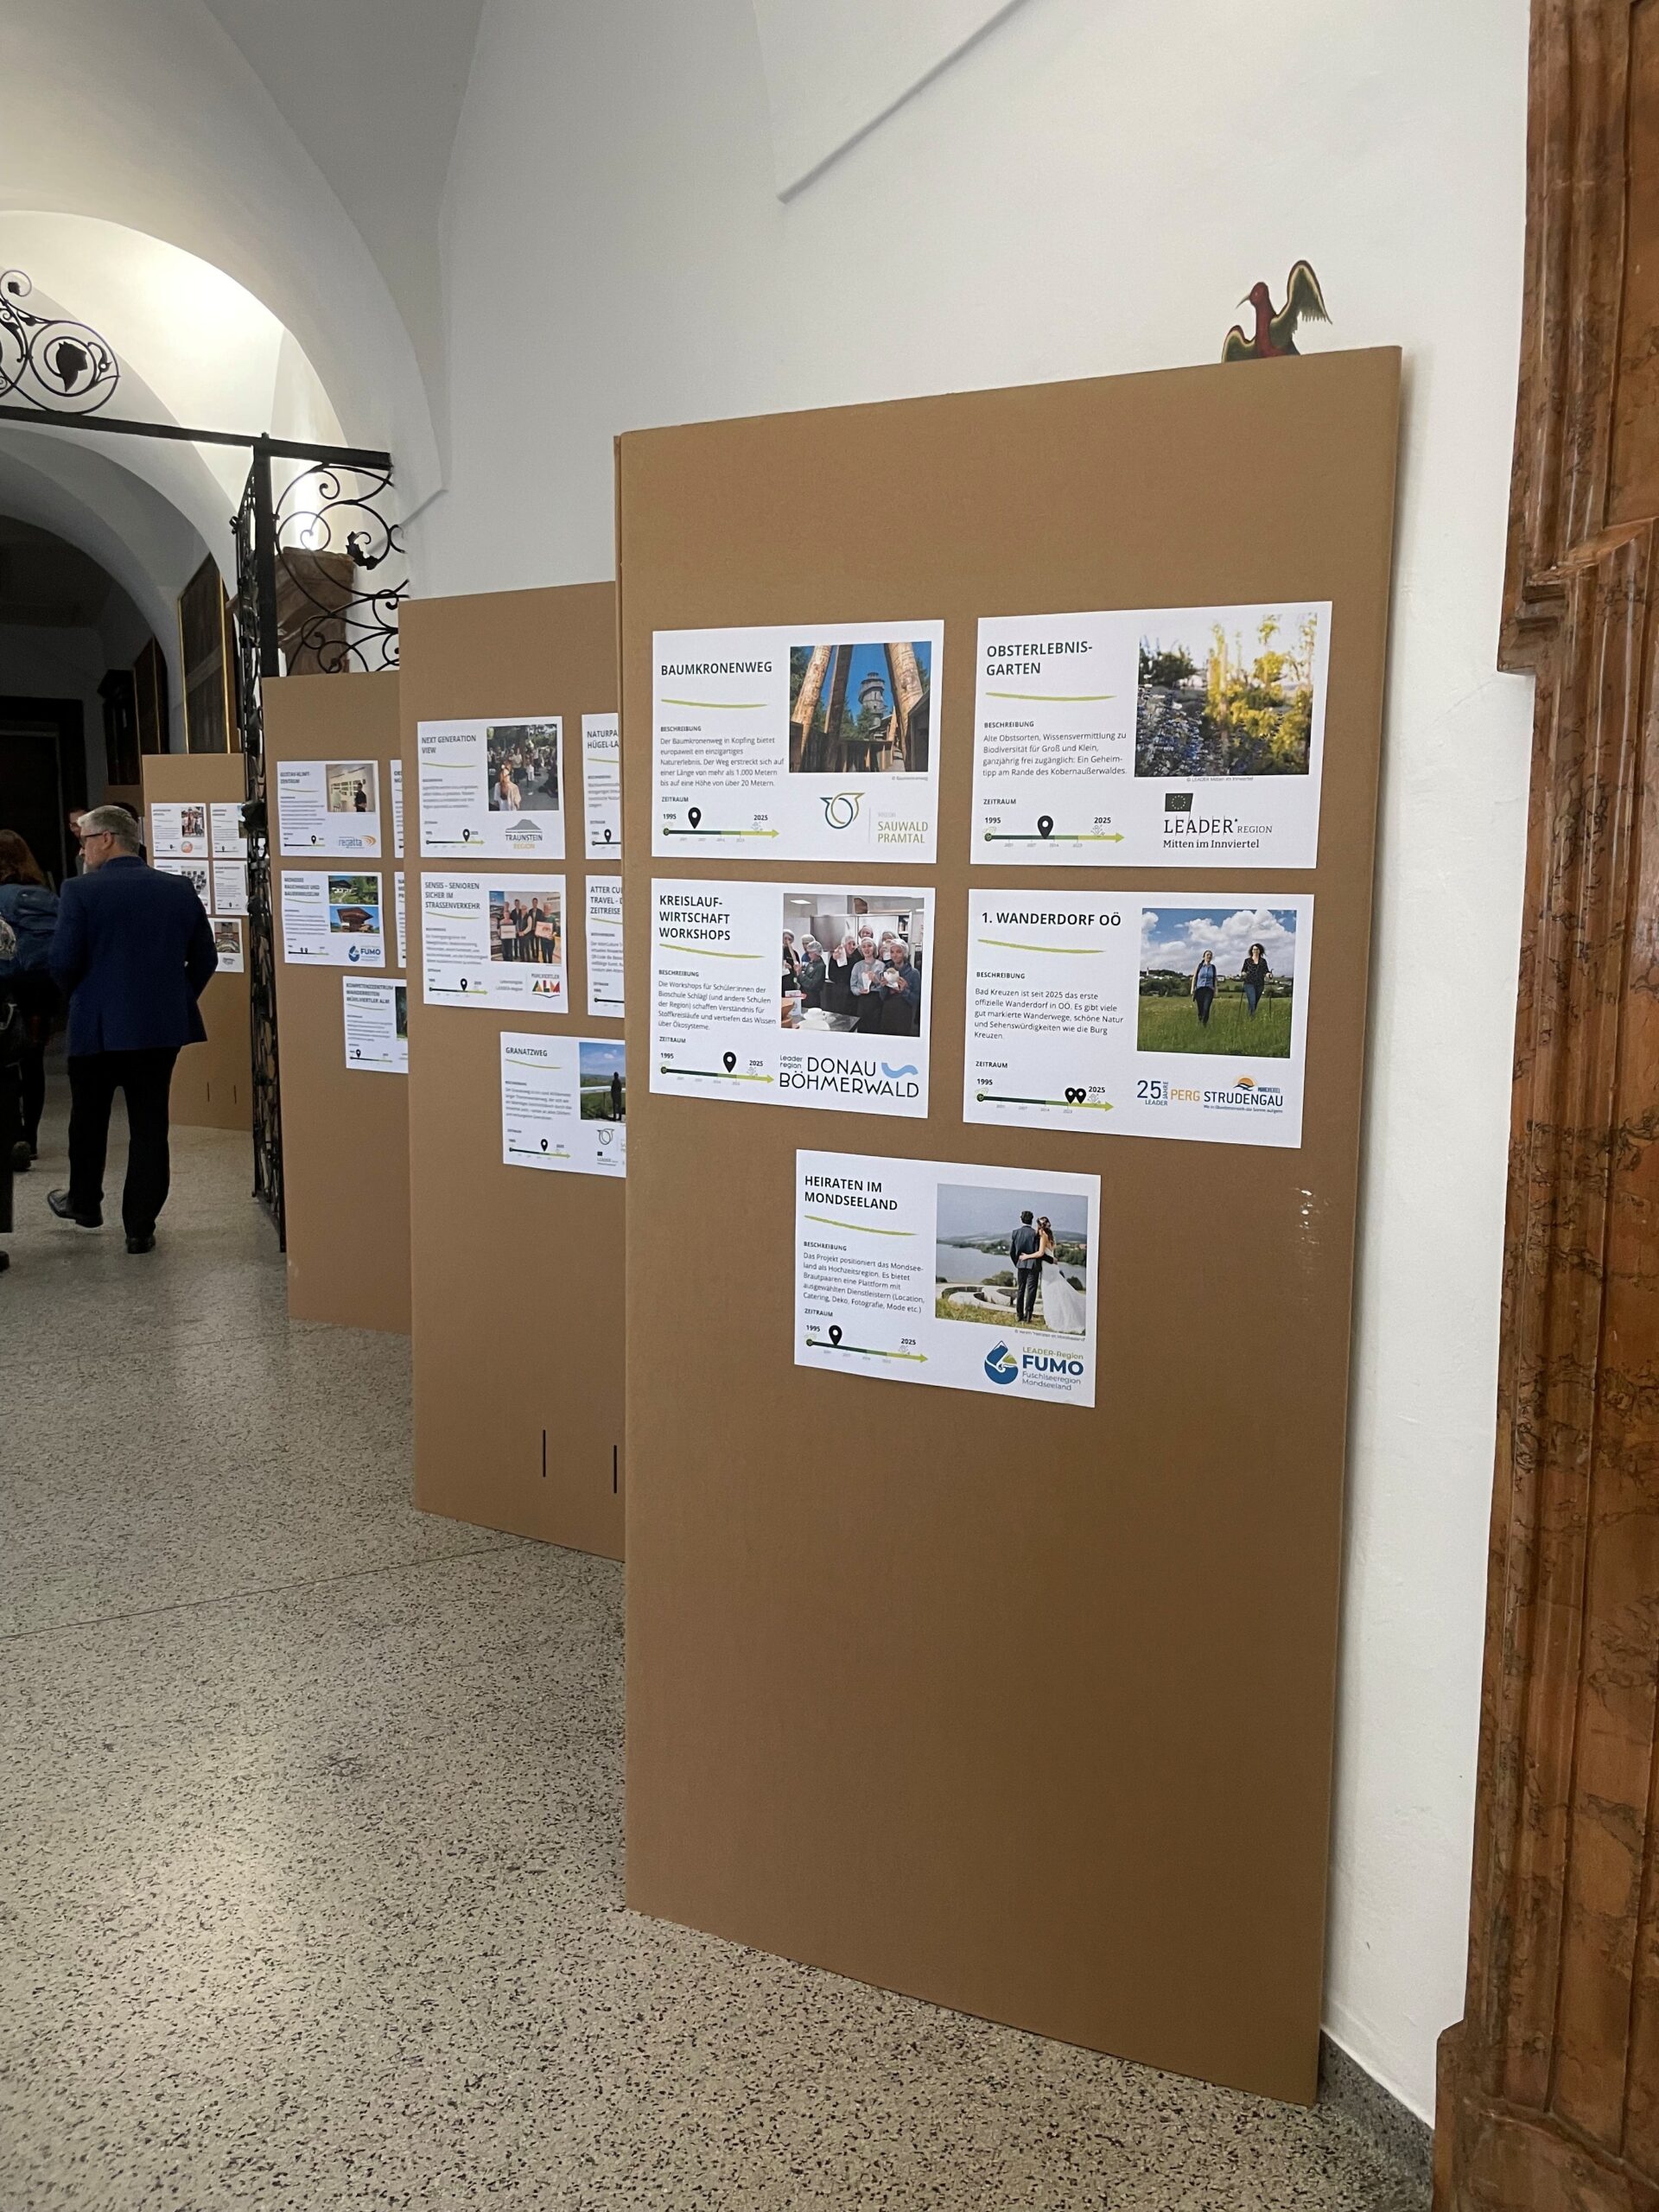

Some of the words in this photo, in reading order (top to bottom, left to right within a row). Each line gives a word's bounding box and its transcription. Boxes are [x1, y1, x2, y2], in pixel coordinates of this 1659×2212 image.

[987, 641, 1092, 657] OBSTERLEBNIS-
[661, 662, 772, 675] BAUMKRONENWEG
[987, 663, 1040, 676] GARTEN
[438, 734, 476, 743] GENERATION
[983, 758, 1019, 766] ganzjährig
[878, 822, 928, 831] SAUWALD
[1164, 817, 1237, 835] LEADER
[878, 834, 925, 842] PRAMTAL
[1211, 839, 1259, 848] Innviertel
[660, 895, 722, 907] KREISLAUF-
[659, 912, 730, 924] WIRTSCHAFT
[982, 912, 993, 923] 1.
[996, 912, 1095, 925] WANDERDORF
[1099, 912, 1121, 925] OÖ
[659, 928, 730, 940] WORKSHOPS
[532, 980, 560, 993] ALM
[1024, 1013, 1071, 1022] Wanderwege,
[990, 1022, 1060, 1032] Sehenswürdigkeiten
[1090, 1027, 1108, 1035] Burg
[505, 1047, 548, 1057] GRANATZWEG
[808, 1057, 876, 1077] DONAU
[779, 1071, 918, 1097] BÖHMERWALD
[1137, 1080, 1161, 1098] 25
[1171, 1090, 1200, 1101] PERG
[1204, 1091, 1283, 1106] STRUDENGAU
[805, 1175, 863, 1190] HEIRATEN
[868, 1182, 881, 1192] IM
[805, 1192, 898, 1210] MONDSEELAND
[804, 1242, 847, 1250] BESCHREIBUNG
[817, 1254, 838, 1262] Projekt
[840, 1257, 875, 1267] positioniert
[891, 1262, 924, 1271] Mondsee-
[829, 1266, 879, 1277] Hochzeitsregion.
[804, 1273, 842, 1283] Brautpaaren
[859, 1280, 888, 1288] Plattform
[804, 1283, 845, 1294] ausgewählten
[847, 1287, 891, 1299] Dienstleistern
[893, 1294, 925, 1303] (Location,
[804, 1293, 830, 1302] Catering,
[852, 1299, 885, 1309] Fotografie,
[804, 1308, 833, 1317] ZEITRAUM
[1022, 1346, 1084, 1360] LEADER-Region
[1022, 1355, 1084, 1376] FUMO
[1022, 1371, 1081, 1384] Fuschlseeregion
[1022, 1378, 1071, 1391] Mondseeland
